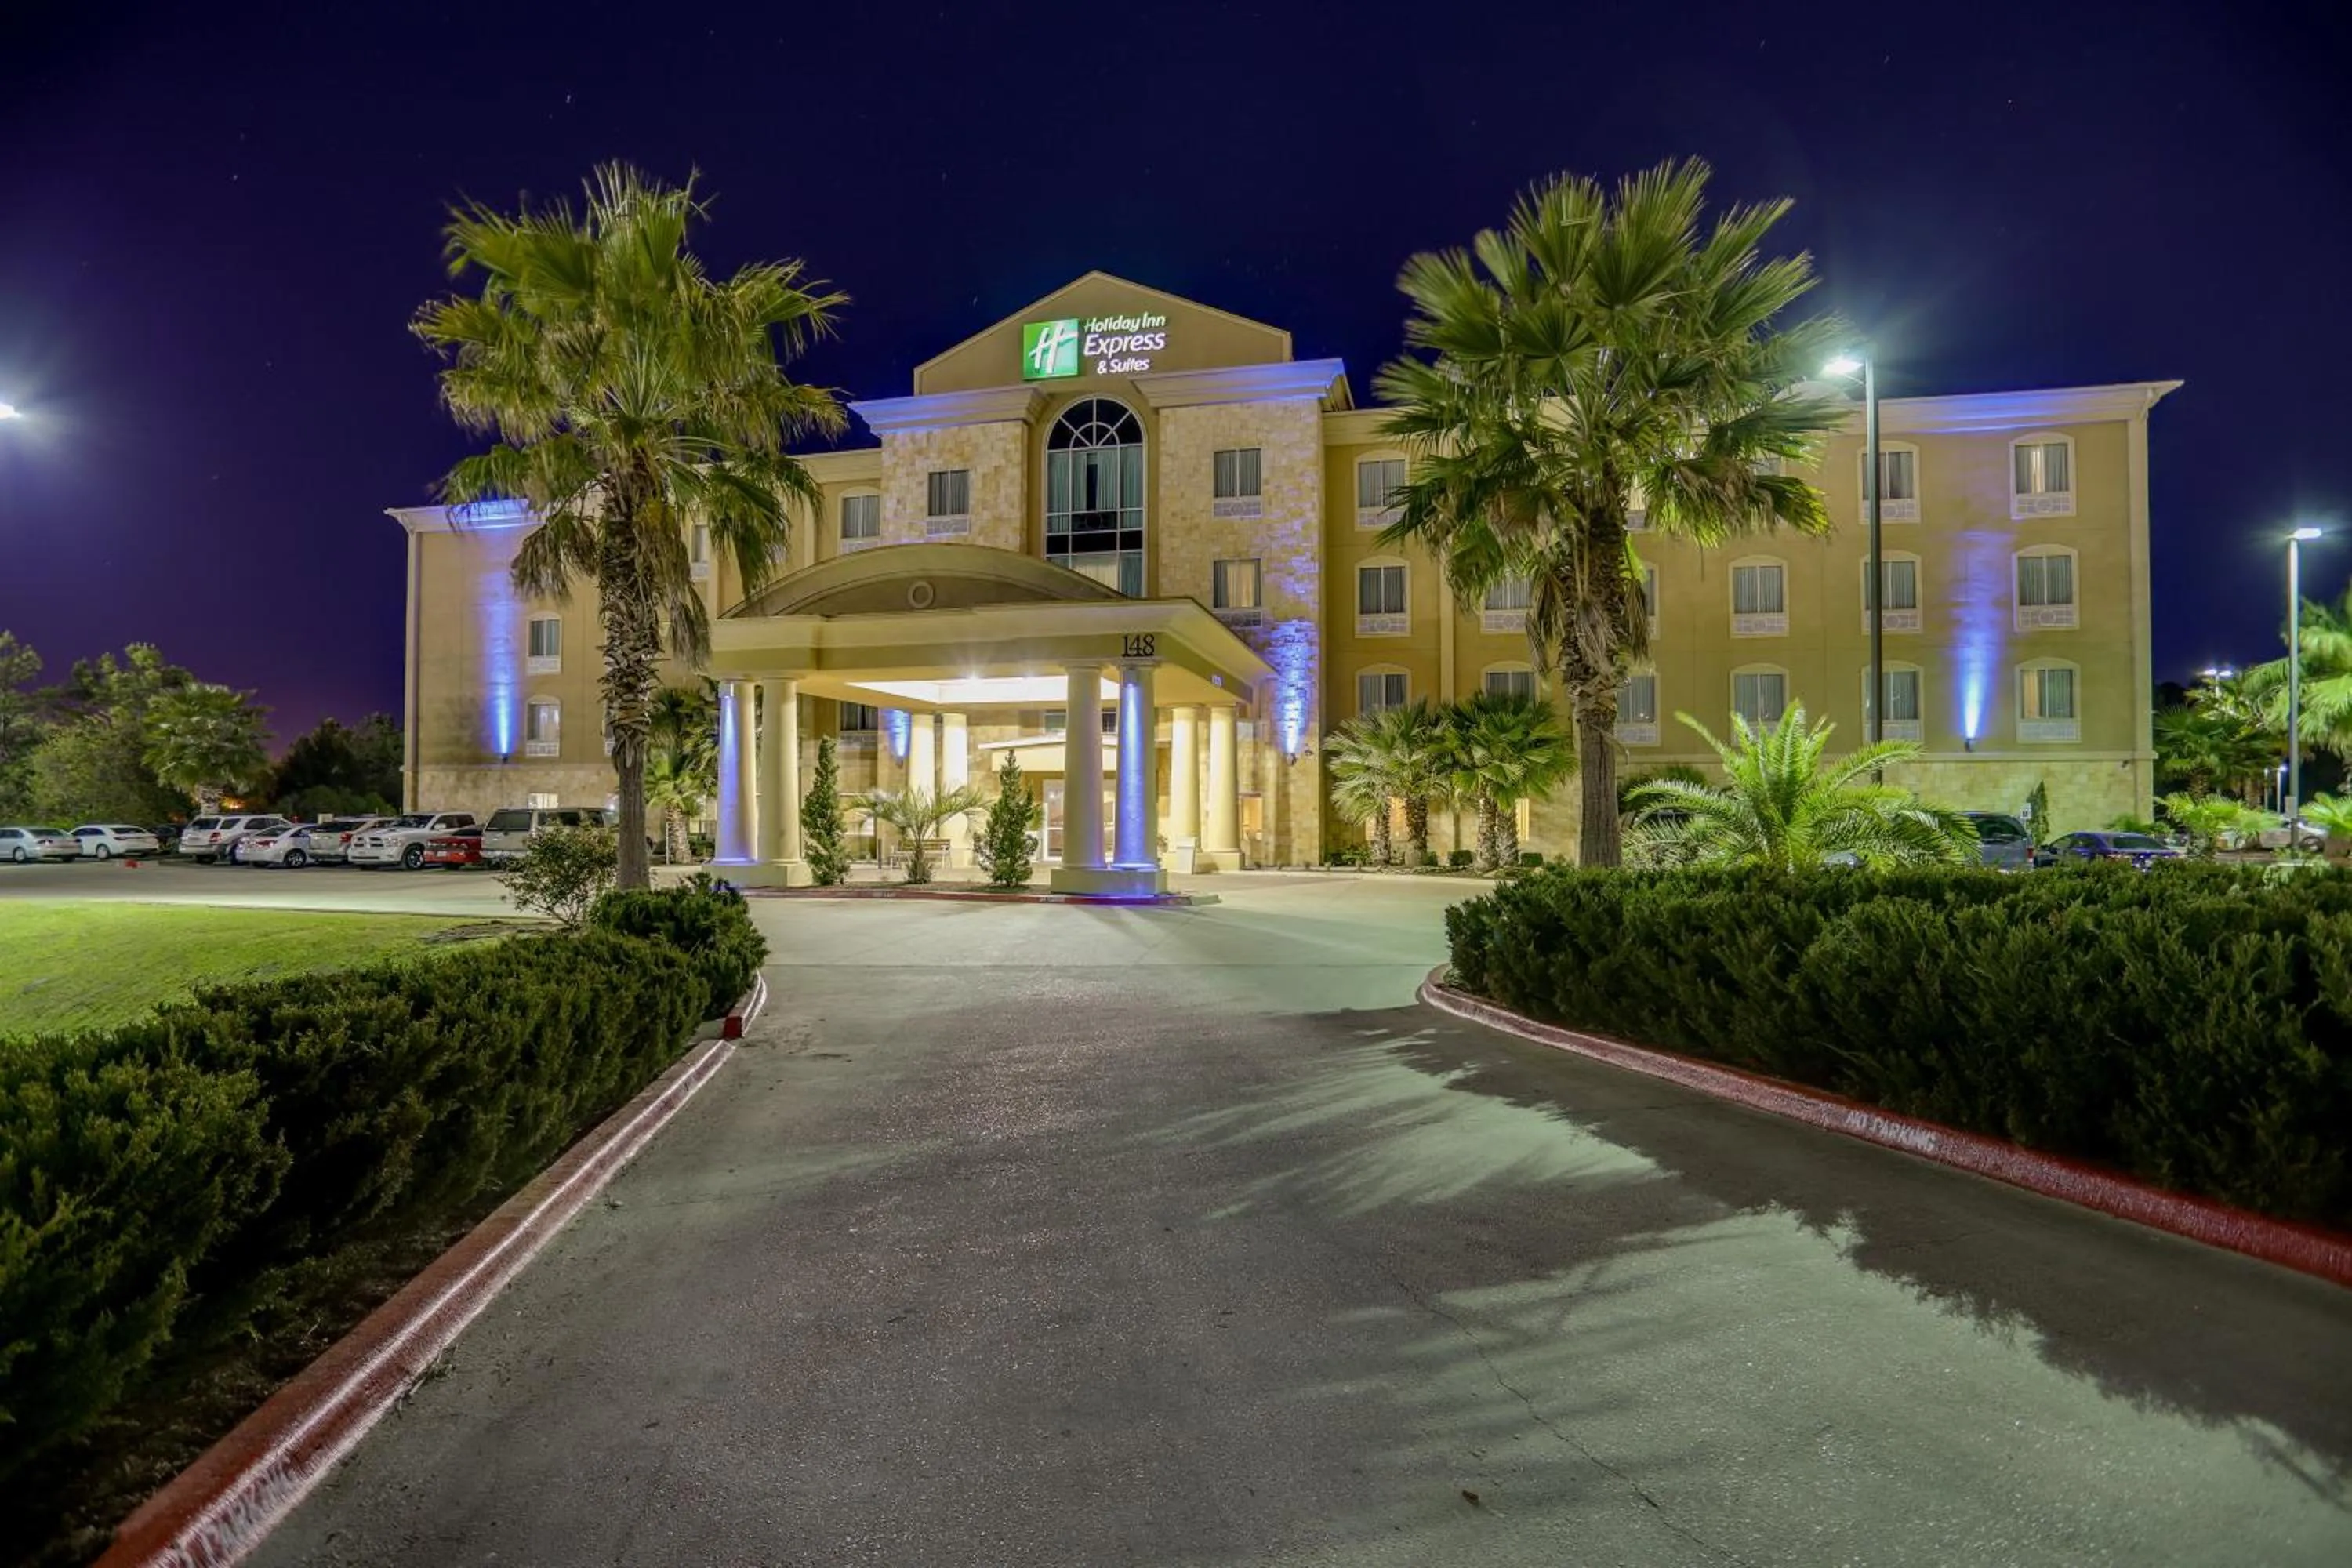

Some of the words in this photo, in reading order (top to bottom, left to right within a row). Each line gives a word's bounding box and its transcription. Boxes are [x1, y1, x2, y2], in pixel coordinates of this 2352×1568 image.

[1084, 315, 1140, 333] Holiday
[1142, 311, 1166, 328] Inn
[1083, 332, 1166, 358] Express
[1097, 362, 1108, 374] &
[1109, 358, 1150, 372] Suites
[1121, 633, 1155, 657] 148
